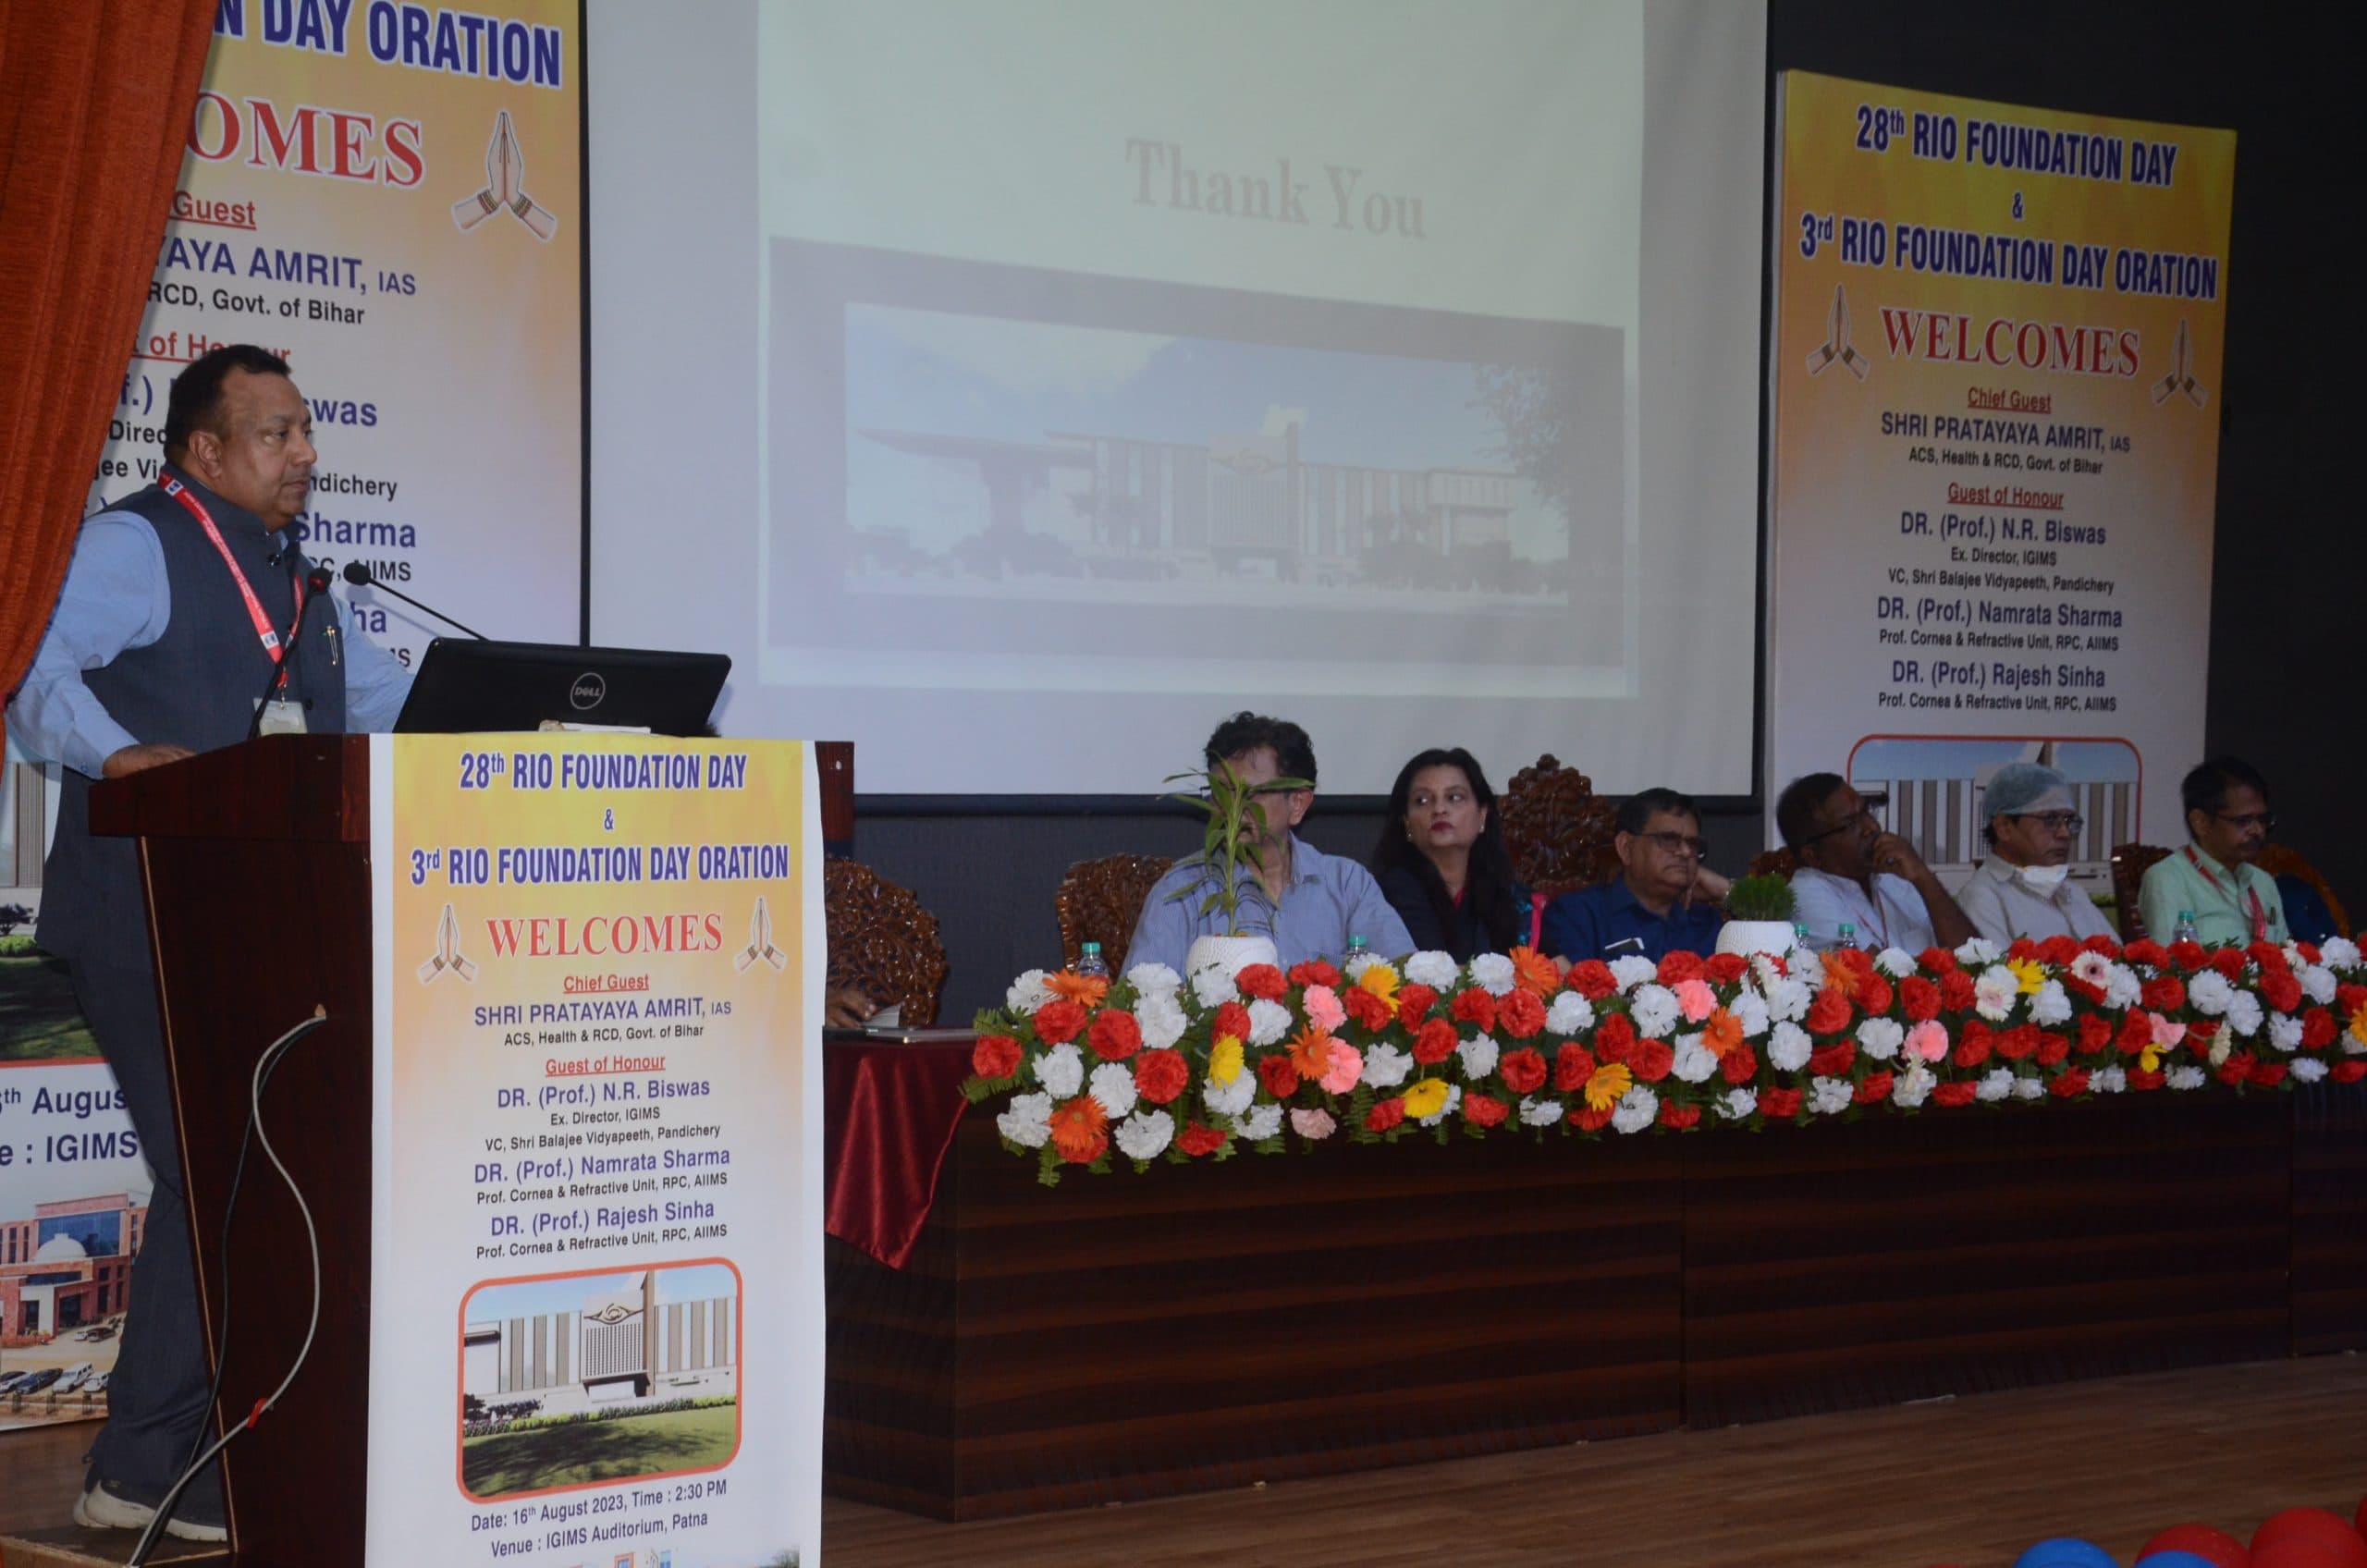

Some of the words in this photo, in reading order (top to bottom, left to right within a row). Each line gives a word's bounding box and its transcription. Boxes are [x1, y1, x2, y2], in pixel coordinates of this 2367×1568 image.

[264, 0, 353, 53] DAY
[370, 0, 560, 86] ORATION
[186, 92, 423, 187] OMES
[1857, 105, 1904, 151] 28th
[1914, 113, 1956, 161] RIO
[1967, 121, 2123, 180] FOUNDATION
[2131, 143, 2177, 186] DAY
[1126, 138, 1308, 226] Thank
[1323, 165, 1425, 239] You
[173, 190, 256, 229] Guest
[2012, 192, 2023, 218] &
[249, 247, 366, 294] AMRIT,
[379, 271, 416, 295] IAS
[1801, 214, 1832, 258] 3rd
[1842, 219, 1884, 265] RIO
[1895, 227, 2053, 283] FOUNDATION
[2063, 245, 2108, 289] DAY
[2116, 250, 2217, 299] ORATION
[213, 288, 271, 314] Govt.
[279, 298, 300, 318] of
[308, 300, 364, 325] Bihar
[150, 332, 177, 357] of
[1881, 308, 2140, 376] WELCOMES
[1968, 387, 2005, 410] Chief
[2010, 394, 2051, 413] Guest
[109, 420, 166, 444] Direc
[1882, 412, 1927, 436] SHRI
[1935, 417, 2039, 447] PRATAYAYA
[2045, 425, 2104, 451] AMRIT,
[2110, 435, 2130, 452] IAS
[1909, 447, 1938, 464] ACS,
[1943, 450, 1979, 466] Health
[1983, 453, 1990, 466] &
[1994, 453, 2023, 470] RCD,
[2027, 458, 2055, 472] Govt.
[2059, 459, 2070, 472] of
[2074, 459, 2103, 473] Bihar
[311, 473, 398, 501] ndichery
[1948, 483, 1989, 503] Guest
[1994, 487, 2007, 506] of
[2013, 487, 2064, 509] Honour
[296, 510, 416, 548] Sharma
[1901, 512, 1932, 535] DR.
[1941, 514, 1995, 544] (Prof.)
[2003, 518, 2038, 541] N.R.
[2046, 520, 2105, 544] Biswas
[1952, 547, 1968, 561] Ex.
[1972, 548, 2018, 564] Director,
[2023, 551, 2056, 565] IGIMS
[1889, 569, 1908, 584] VC,
[1913, 570, 1935, 585] Shri
[1940, 571, 1981, 589] Balajee
[1985, 574, 2050, 592] Vidyapeeth,
[2054, 576, 2114, 595] Pandichery
[1877, 596, 1908, 619] DR.
[1917, 599, 1971, 626] (Prof.)
[1979, 601, 2051, 625] Namrata
[2058, 605, 2121, 627] Sharma
[1880, 630, 1907, 643] Prof.
[1911, 631, 1952, 645] Cornea
[1956, 632, 1963, 645] &
[1968, 633, 2023, 648] Refractive
[2028, 635, 2053, 650] Unit,
[2056, 636, 2082, 651] RPC,
[2087, 637, 2118, 651] AIIMS
[1893, 661, 1923, 683] DR.
[1932, 661, 1986, 689] (Prof.)
[1993, 663, 2051, 690] Rajesh
[2058, 666, 2104, 687] Sinha
[574, 687, 600, 697] DELL
[1879, 693, 1905, 706] Prof.
[1910, 694, 1951, 708] Cornea
[1955, 694, 1962, 707] &
[1966, 695, 2022, 710] Refractive
[2026, 696, 2051, 711] Unit,
[2054, 697, 2081, 712] RPC,
[2085, 697, 2116, 712] AIIMS
[460, 753, 505, 788] 28th
[513, 755, 552, 788] RIO
[562, 754, 699, 789] FOUNDATION
[708, 754, 747, 788] DAY
[605, 809, 614, 829] &
[411, 849, 440, 885] 3rd
[449, 849, 488, 884] RIO
[498, 847, 642, 883] FOUNDATION
[651, 847, 690, 880] DAY
[698, 845, 789, 879] ORATION
[487, 913, 722, 958] WELCOMES
[564, 976, 602, 993] Chief
[607, 974, 649, 991] Guest
[474, 1006, 521, 1026] SHRI
[531, 1000, 638, 1023] PRATAYAYA
[645, 998, 705, 1018] AMRIT,
[711, 1001, 731, 1014] IAS
[505, 1030, 534, 1047] ACS,
[539, 1029, 576, 1045] Health
[582, 1029, 588, 1042] &
[593, 1028, 621, 1043] RCD,
[626, 1027, 656, 1039] Govt.
[660, 1026, 670, 1037] of
[675, 1024, 703, 1036] Bihar
[546, 1059, 588, 1076] Guest
[594, 1056, 607, 1073] of
[613, 1056, 666, 1072] Honour
[32, 1087, 128, 1119] Augus
[498, 1088, 531, 1108] DR.
[539, 1084, 595, 1109] (Prof.)
[603, 1082, 640, 1102] N.R.
[648, 1080, 710, 1098] Biswas
[550, 1113, 568, 1126] Ex.
[573, 1109, 620, 1124] Director,
[626, 1107, 660, 1121] IGIMS
[47, 1131, 138, 1162] IGIMS
[485, 1137, 507, 1153] VC,
[510, 1135, 534, 1150] Shri
[539, 1133, 582, 1149] Balajee
[586, 1127, 654, 1145] Vidyapeeth,
[657, 1124, 720, 1140] Pandichery
[474, 1164, 508, 1183] DR.
[516, 1159, 574, 1183] (Prof.)
[582, 1153, 657, 1175] Namrata
[664, 1148, 730, 1168] Sharma
[477, 1190, 506, 1204] Prof.
[510, 1187, 553, 1202] Cornea
[558, 1184, 565, 1198] &
[570, 1180, 628, 1197] Refractive
[632, 1178, 658, 1193] Unit,
[662, 1176, 690, 1191] RPC,
[694, 1172, 728, 1187] AIIMS
[491, 1216, 525, 1237] DR.
[533, 1212, 589, 1237] (Prof.)
[597, 1206, 657, 1228] Rajesh
[666, 1201, 714, 1220] Sinha
[476, 1244, 505, 1259] Prof.
[509, 1241, 553, 1256] Cornea
[558, 1240, 565, 1252] &
[570, 1233, 628, 1250] Refractive
[632, 1230, 658, 1246] Unit,
[662, 1228, 690, 1243] RPC,
[693, 1224, 727, 1240] AIIMS
[472, 1513, 507, 1532] Date:
[513, 1507, 535, 1525] 16th
[540, 1500, 588, 1524] August
[593, 1495, 627, 1513] 2023,
[632, 1489, 662, 1508] Time
[676, 1484, 702, 1501] 2:30
[706, 1479, 727, 1496] PM
[492, 1535, 533, 1558] Venue
[546, 1527, 586, 1549] IGIMS
[592, 1517, 667, 1542] Auditorium,
[673, 1512, 707, 1529] Patna
